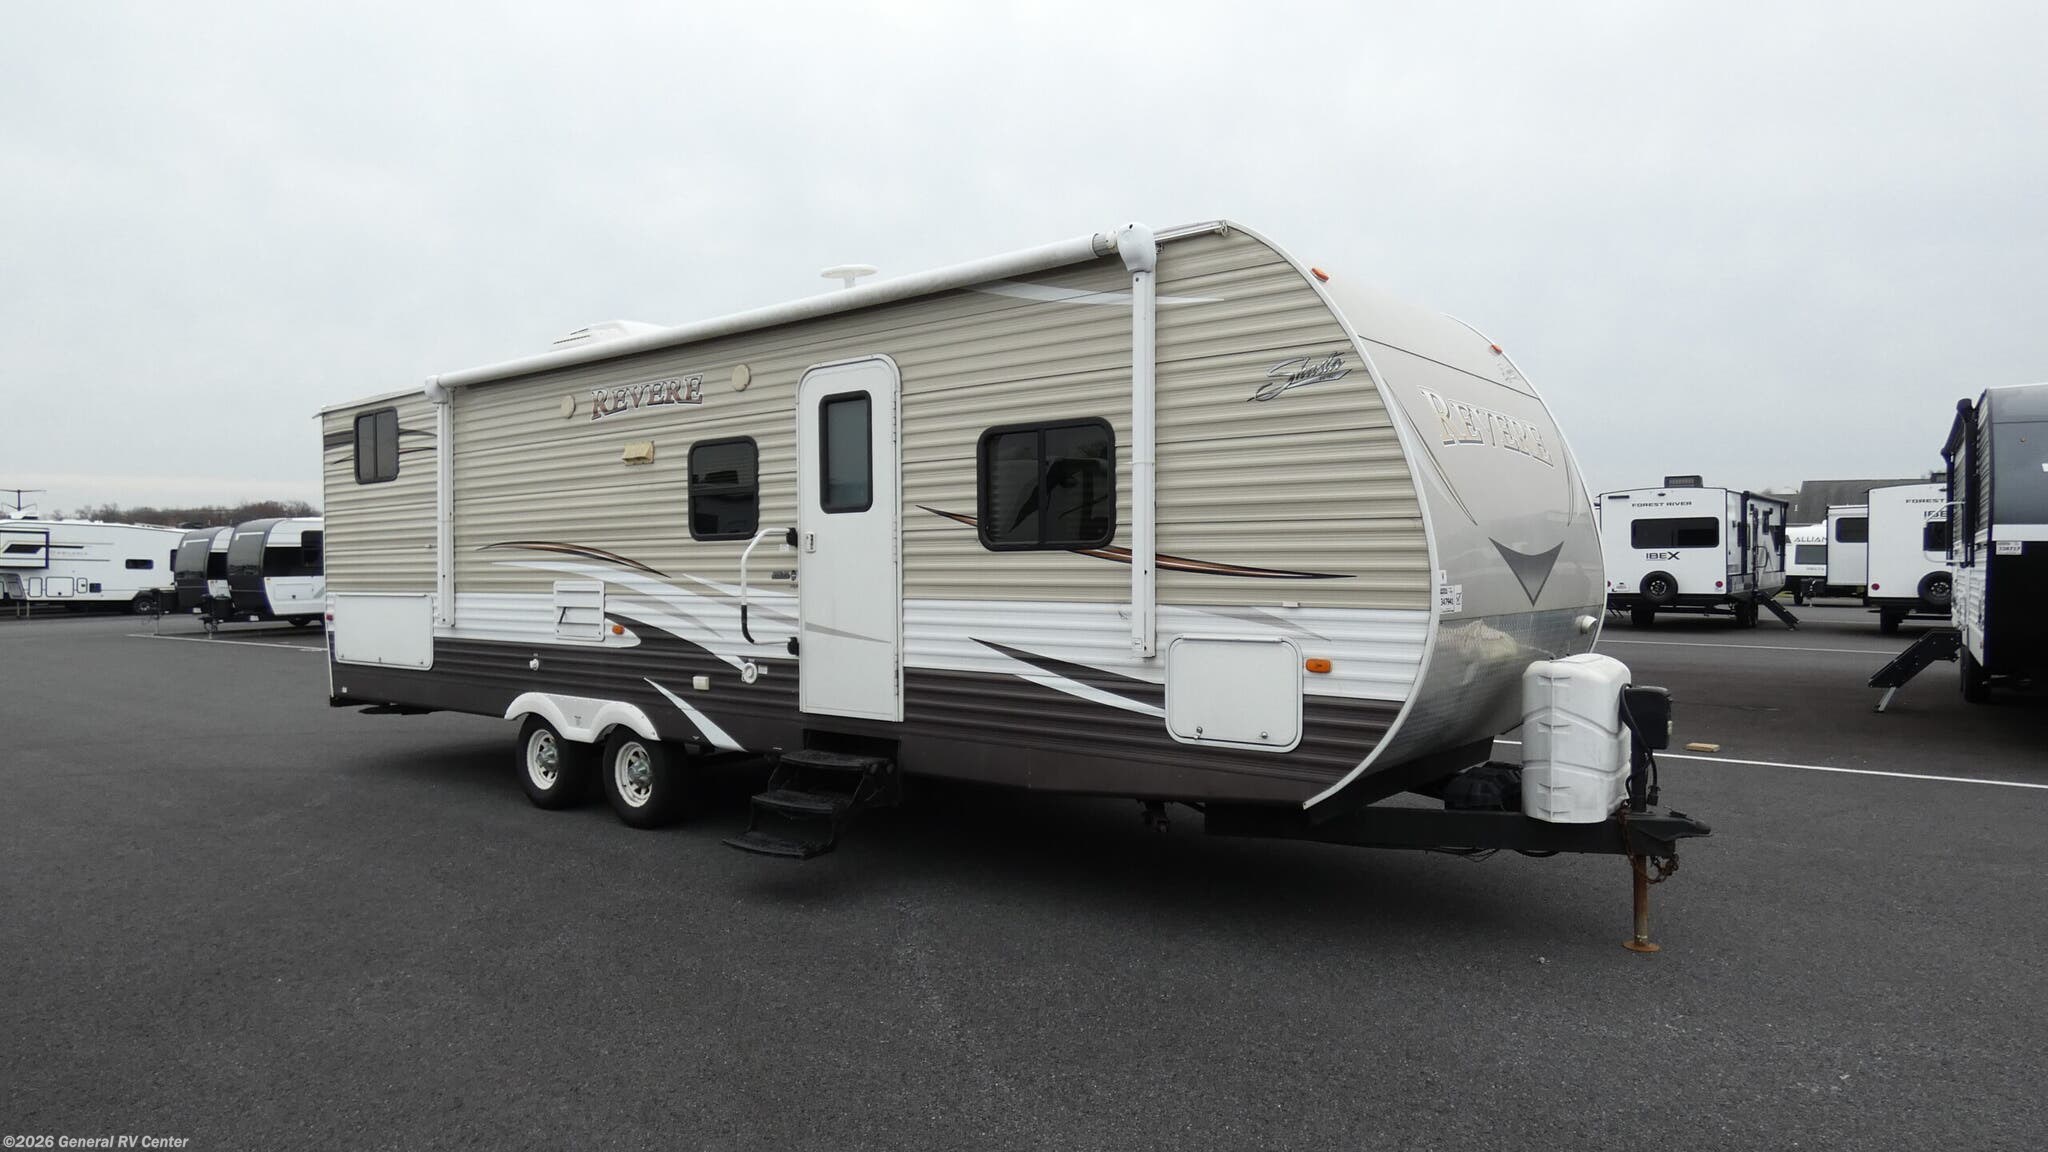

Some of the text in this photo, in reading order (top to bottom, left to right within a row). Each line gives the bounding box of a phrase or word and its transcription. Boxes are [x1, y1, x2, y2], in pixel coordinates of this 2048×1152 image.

[591, 374, 703, 420] REVERE
[1417, 385, 1554, 468] REVERE
[1923, 510, 1947, 518] IBE
[1646, 551, 1680, 561] IBEX
